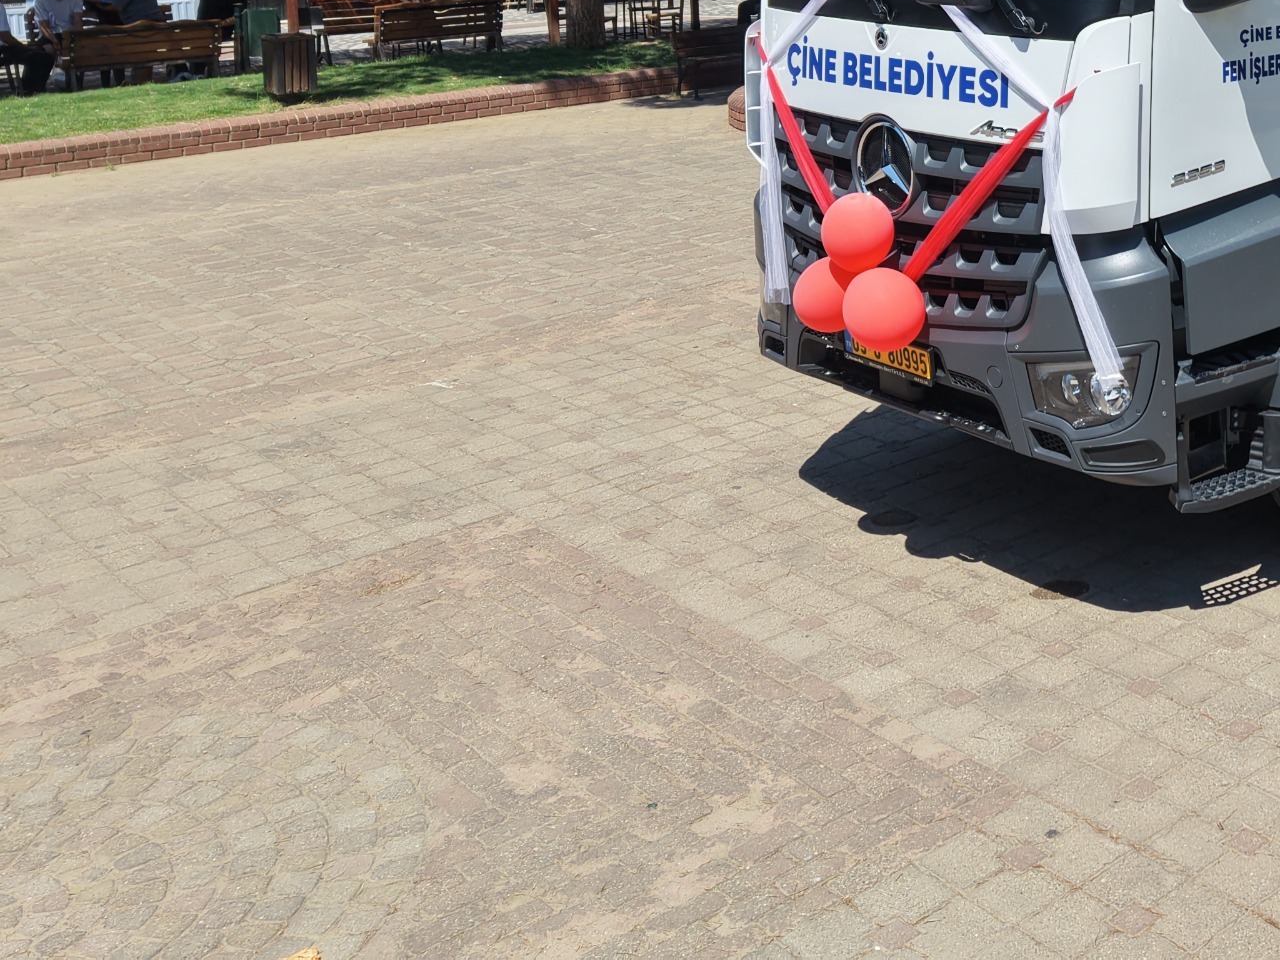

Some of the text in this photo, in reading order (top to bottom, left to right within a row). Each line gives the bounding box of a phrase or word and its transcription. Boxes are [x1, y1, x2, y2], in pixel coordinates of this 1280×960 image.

[1240, 24, 1273, 47] ÇİNE
[787, 35, 837, 86] ÇİNE
[1223, 58, 1247, 83] FEN
